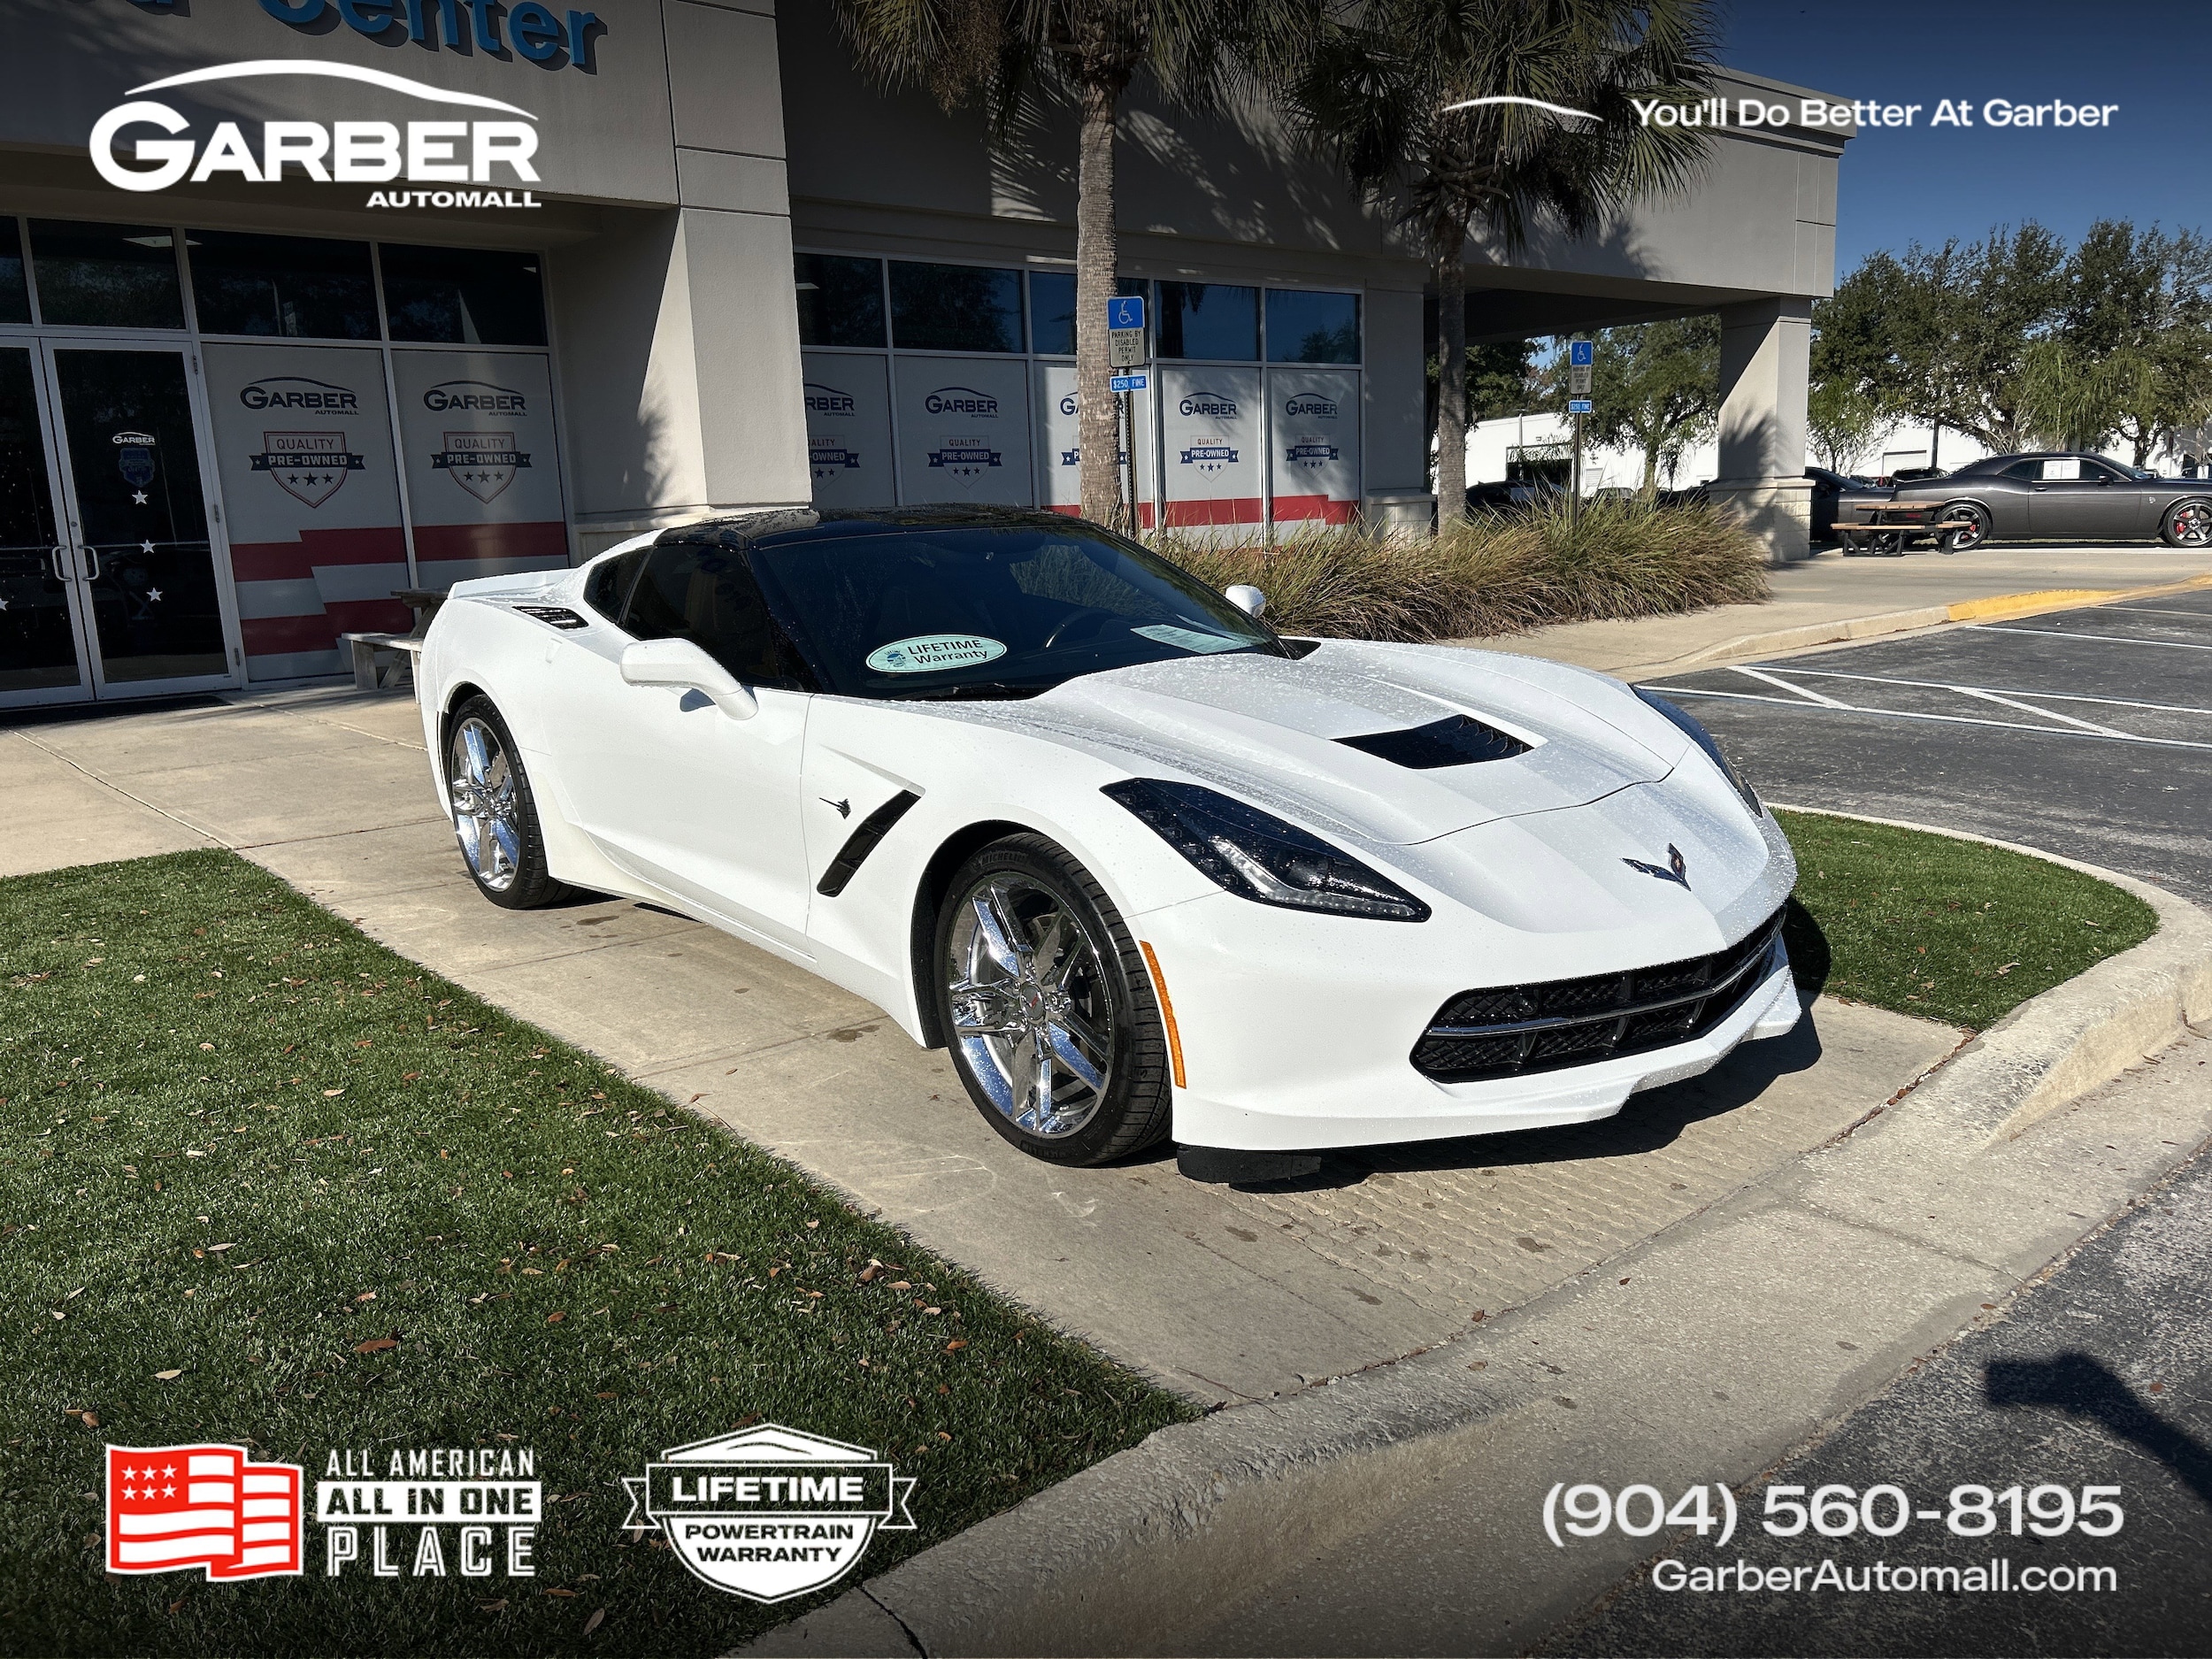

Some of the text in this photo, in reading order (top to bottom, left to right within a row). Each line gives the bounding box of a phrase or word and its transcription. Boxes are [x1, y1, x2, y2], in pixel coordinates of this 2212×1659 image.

[1112, 378, 1145, 389] $250 FINE
[240, 386, 358, 410] GARBER
[423, 389, 526, 411] GARBER
[805, 396, 856, 411] RBER
[925, 395, 999, 414] GARBER
[1179, 399, 1238, 417] GARBER
[1286, 399, 1338, 417] GARBER
[111, 435, 156, 444] GARBER
[276, 438, 334, 450] QUALITY
[454, 438, 505, 449] QUALITY
[810, 451, 846, 461] -OWNED
[941, 451, 990, 461] PRE-OWNED
[1191, 449, 1230, 458] PRE-OWNED
[1295, 447, 1331, 456] PRE-OWNED
[267, 455, 348, 465] PRE-OWNED
[447, 454, 517, 464] PRE-OWNED
[907, 640, 984, 655] LIFETIME
[913, 650, 988, 664] Warranty
